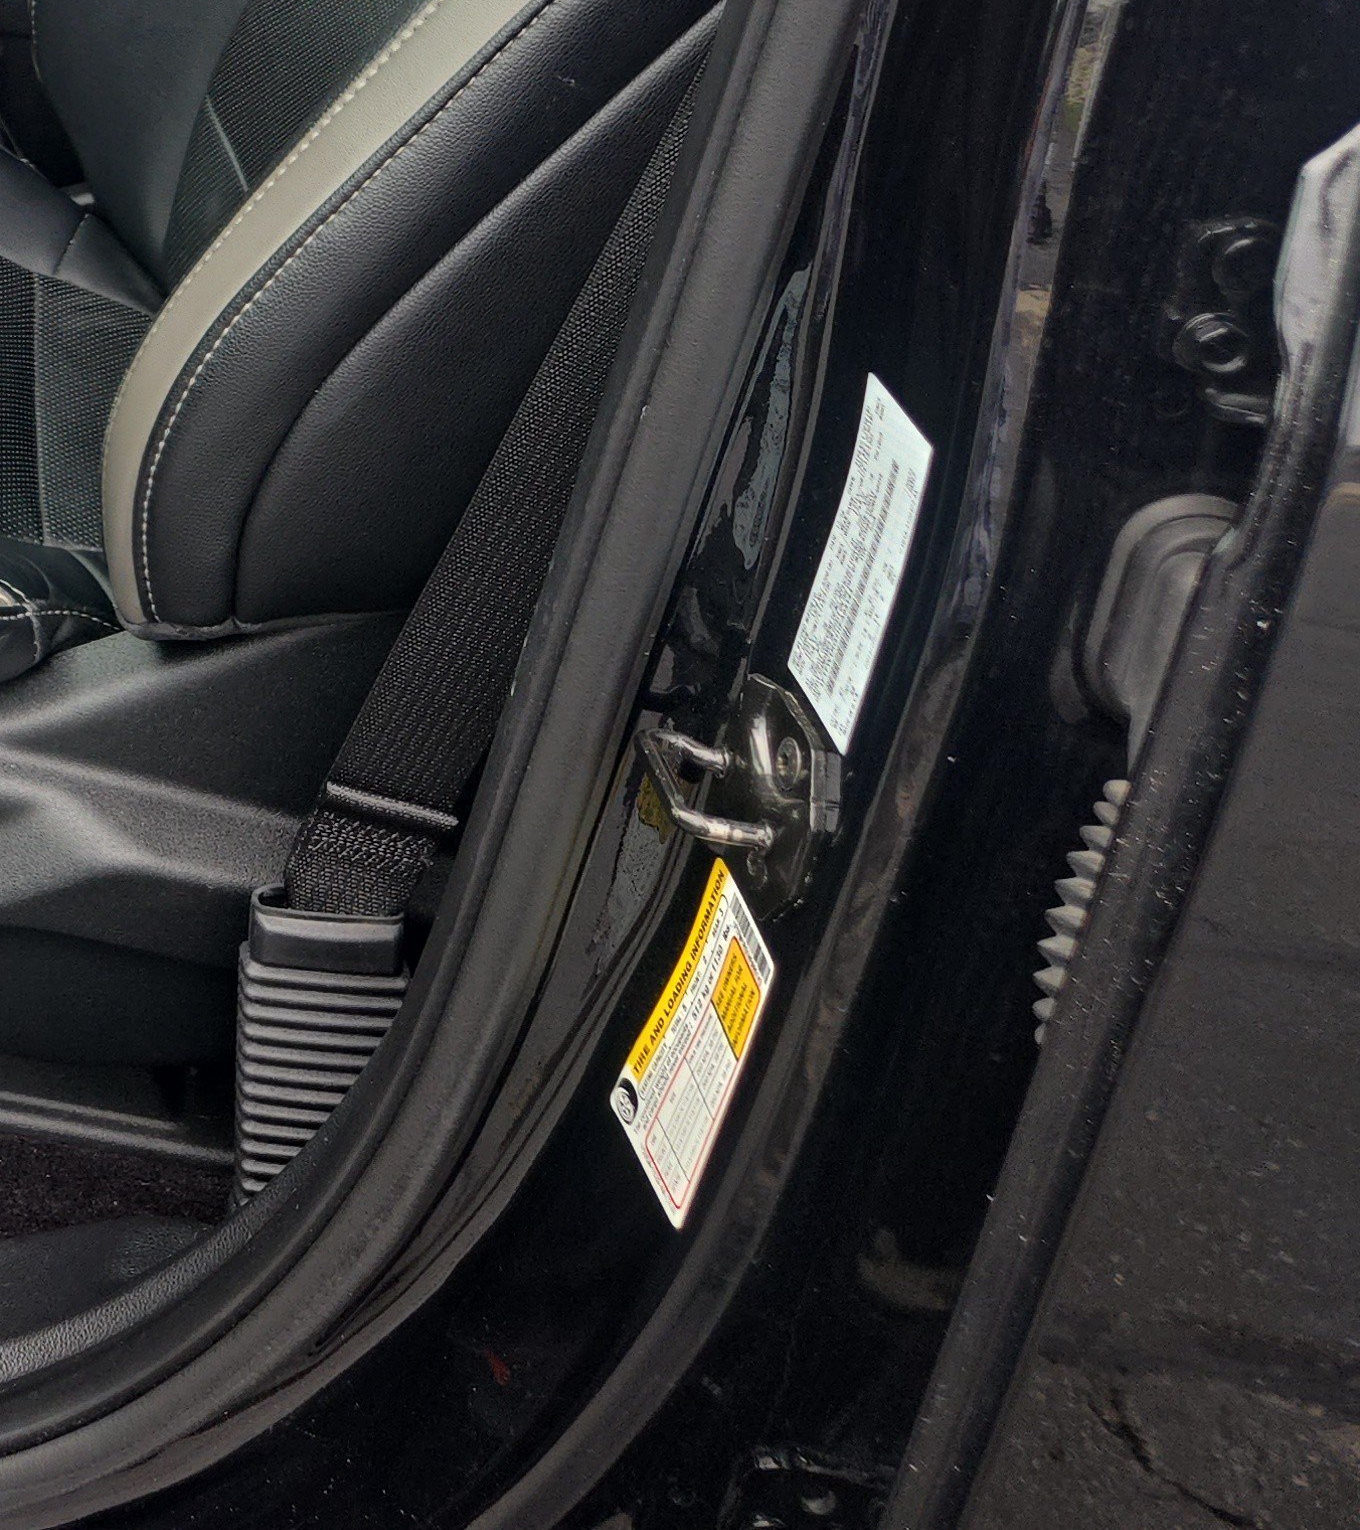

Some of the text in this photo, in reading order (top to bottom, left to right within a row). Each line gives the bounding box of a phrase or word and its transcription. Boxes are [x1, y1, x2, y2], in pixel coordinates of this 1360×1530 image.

[634, 870, 724, 1074] TIRE AND LOADING INFORMATION
